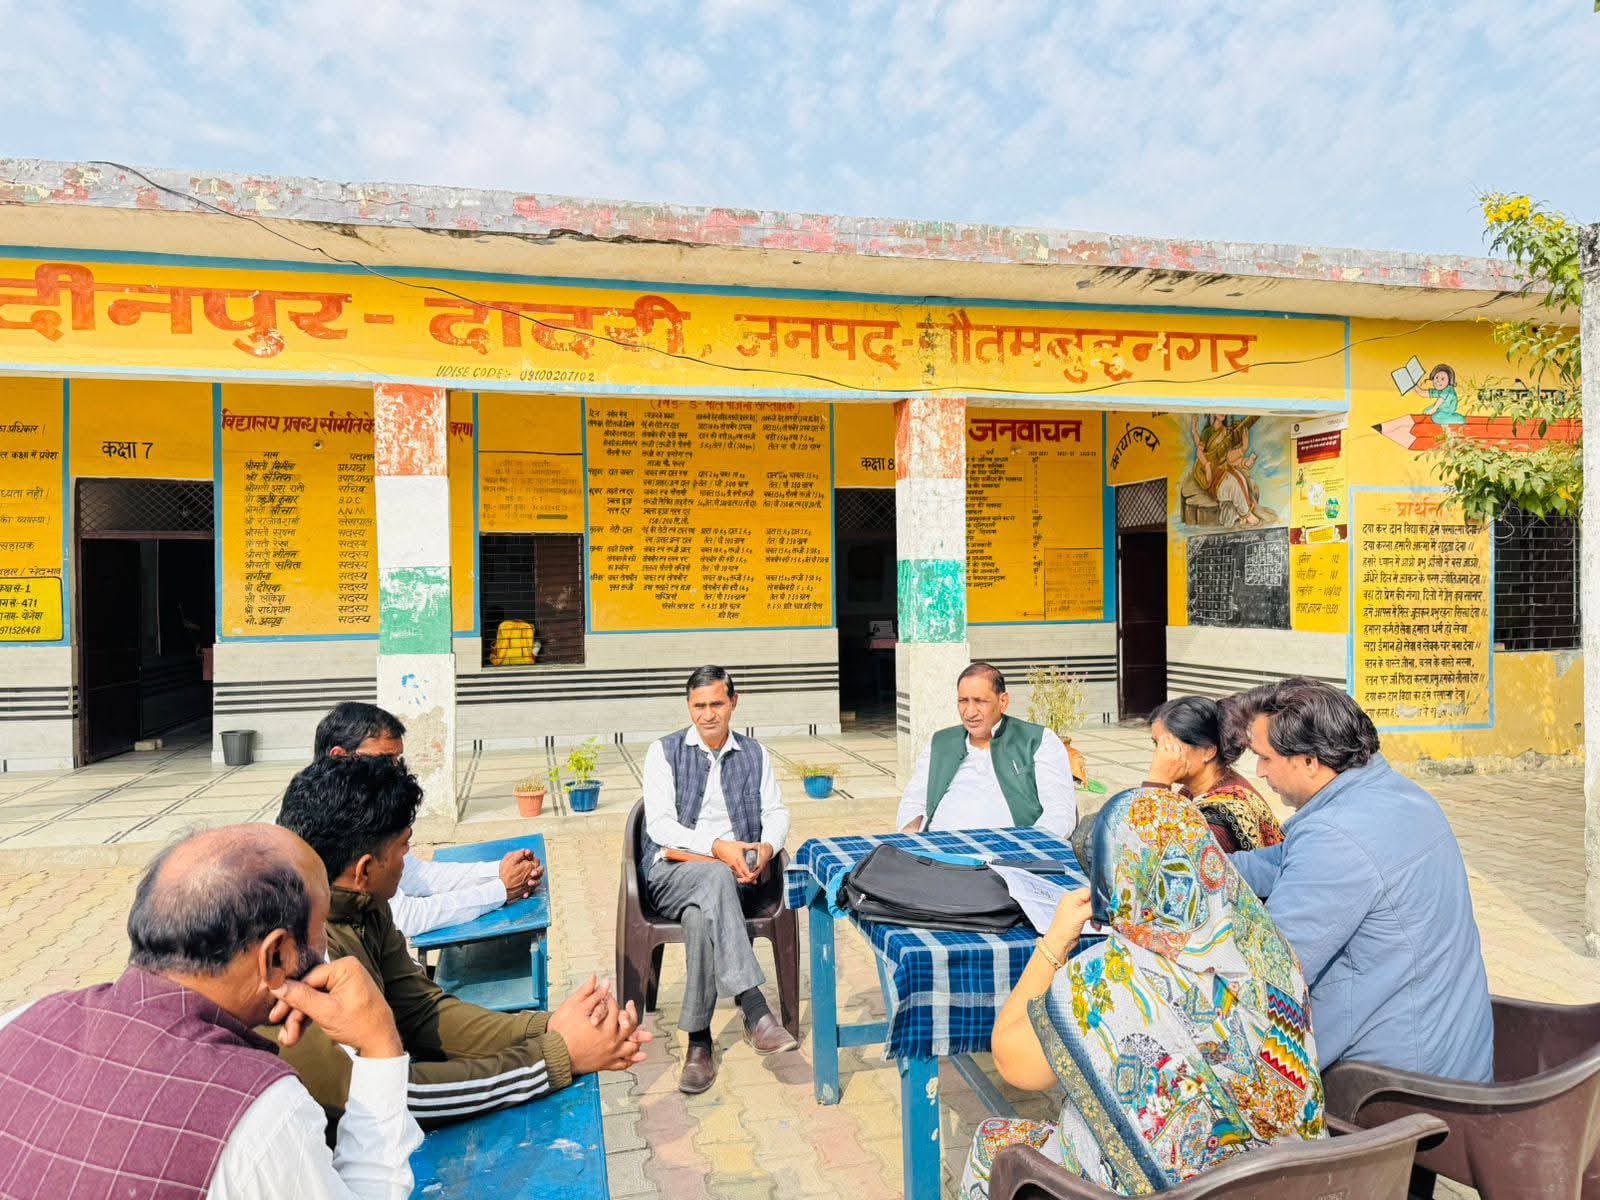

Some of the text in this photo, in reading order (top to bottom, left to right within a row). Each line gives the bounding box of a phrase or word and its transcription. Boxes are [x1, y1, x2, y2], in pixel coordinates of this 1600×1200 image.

[436, 366, 470, 377] UDISE
[221, 408, 280, 432] विद्यालय
[282, 416, 317, 433] प्रबन्ध
[968, 418, 1082, 443] जनवाचन
[101, 440, 154, 460] कक्षा 7
[1110, 423, 1160, 470] कार्यालय
[263, 451, 280, 459] नाम
[861, 456, 895, 471] कक्षा 8
[1363, 524, 1374, 534] दया
[1376, 524, 1387, 534] कर
[1389, 524, 1402, 535] दान
[1363, 541, 1374, 550] दया
[1380, 570, 1391, 583] दिल
[338, 583, 368, 591] सदस्य
[1384, 587, 1395, 600] प्रेम
[1396, 587, 1405, 600] की
[338, 593, 369, 603] सदस्य
[338, 604, 369, 614] सदस्य
[338, 615, 371, 624] सदस्य
[1382, 622, 1393, 634] कर्म
[1432, 620, 1443, 634] धर्म
[1453, 621, 1468, 634] सेवा
[1378, 638, 1395, 651] ईमान
